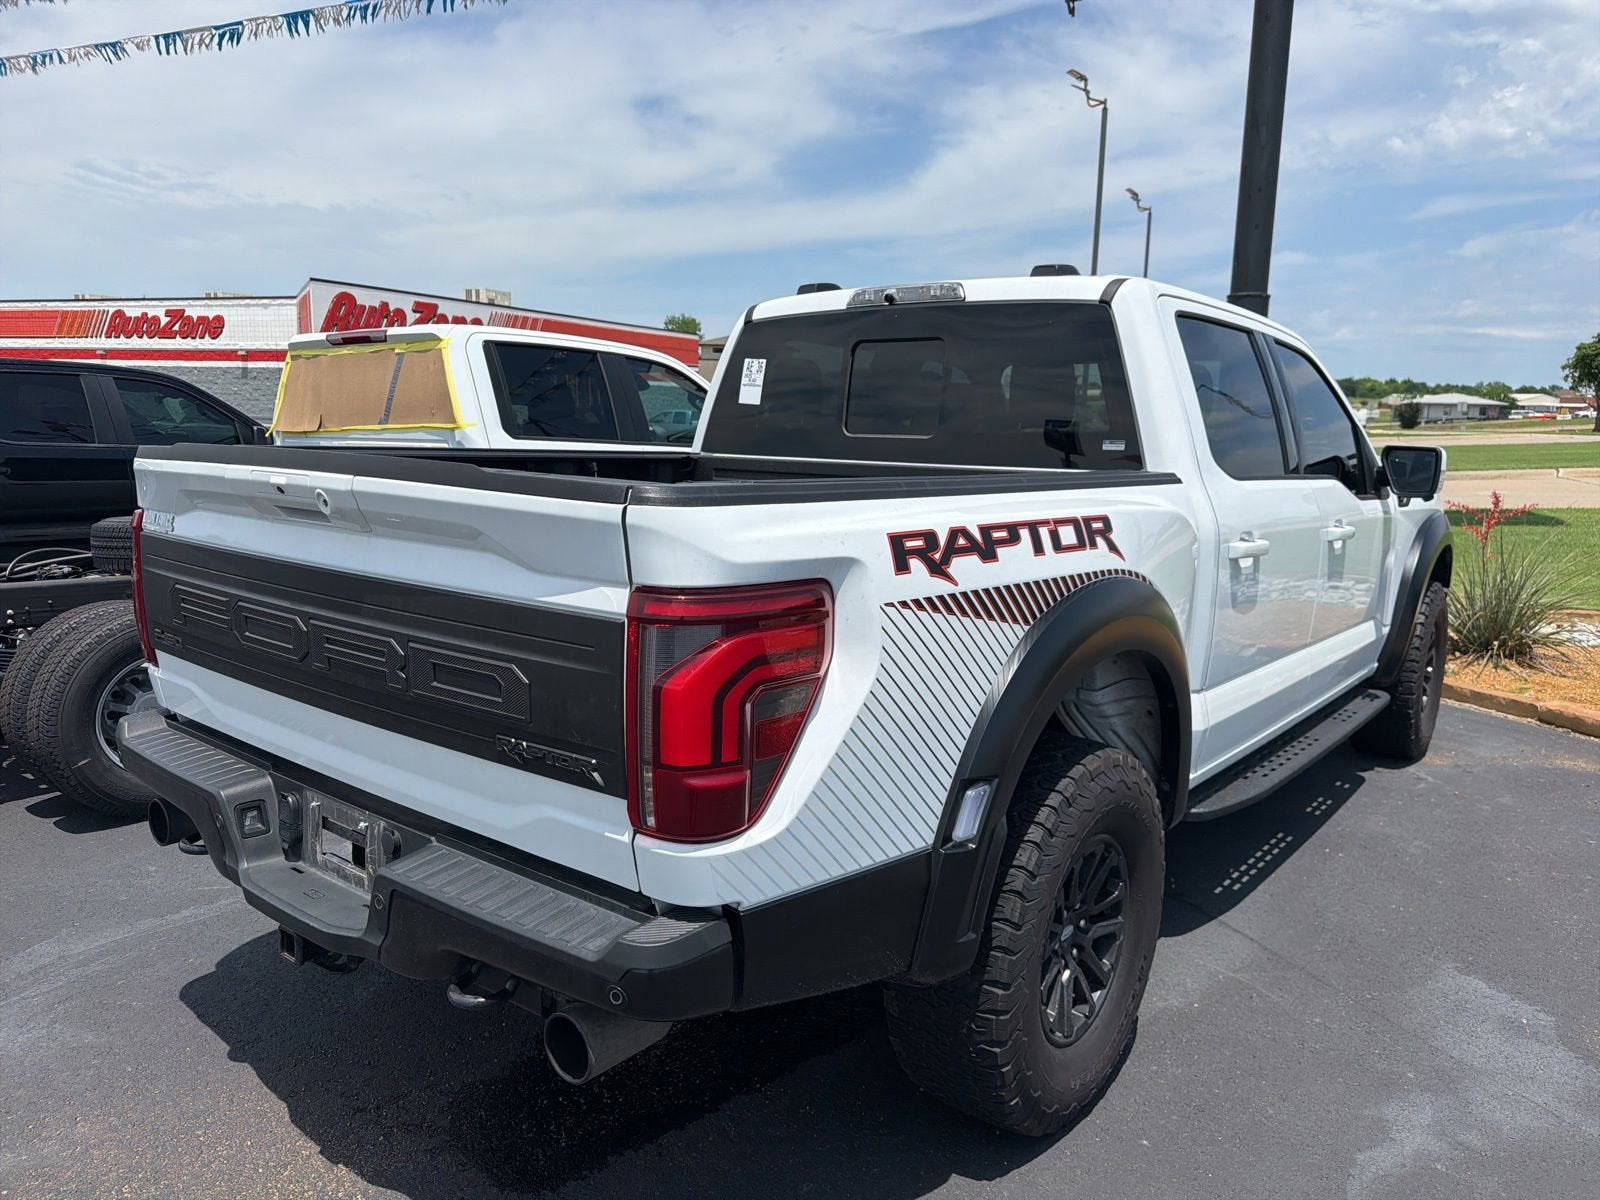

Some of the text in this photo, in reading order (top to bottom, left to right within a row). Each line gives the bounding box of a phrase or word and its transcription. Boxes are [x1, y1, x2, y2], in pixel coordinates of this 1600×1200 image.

[104, 309, 225, 339] AutoZone
[320, 291, 483, 333] AutoZ
[887, 514, 1126, 586] RAPTOR
[169, 582, 532, 724] FORD
